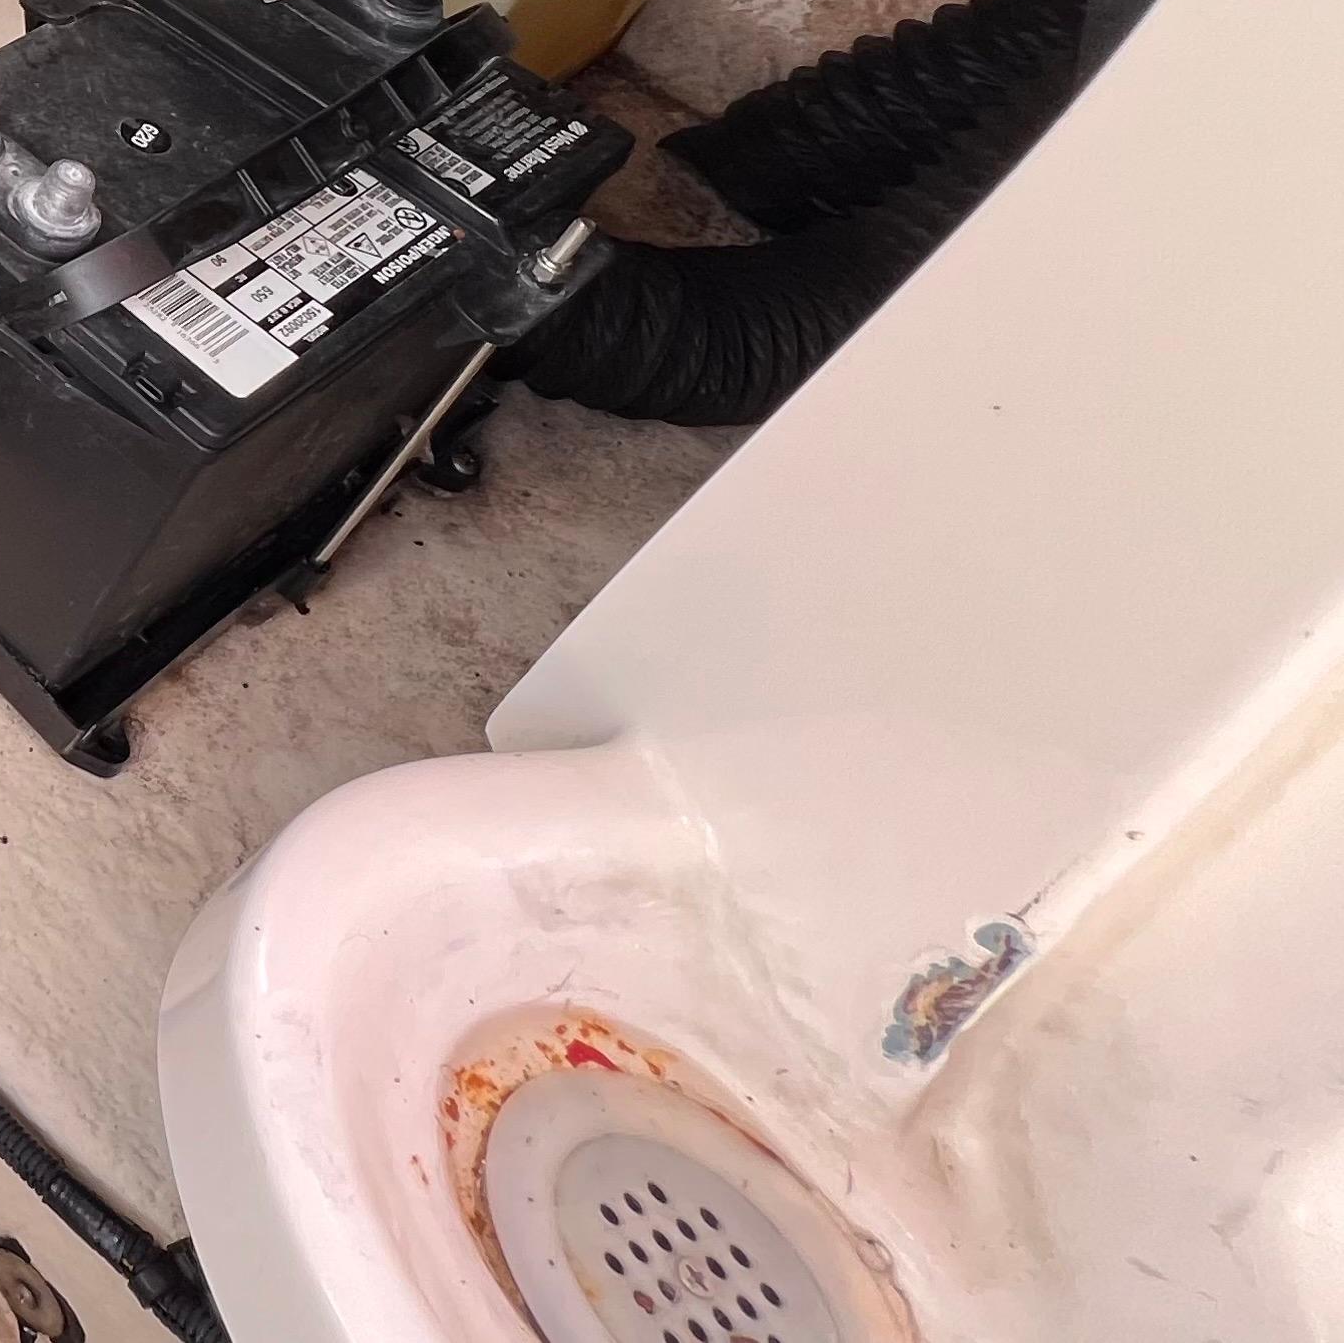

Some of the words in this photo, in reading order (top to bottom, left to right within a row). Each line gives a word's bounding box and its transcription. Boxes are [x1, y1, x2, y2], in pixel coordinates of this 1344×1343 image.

[539, 129, 580, 155] West
[503, 147, 553, 180] Marine
[210, 254, 227, 267] 90
[251, 285, 274, 303] 650
